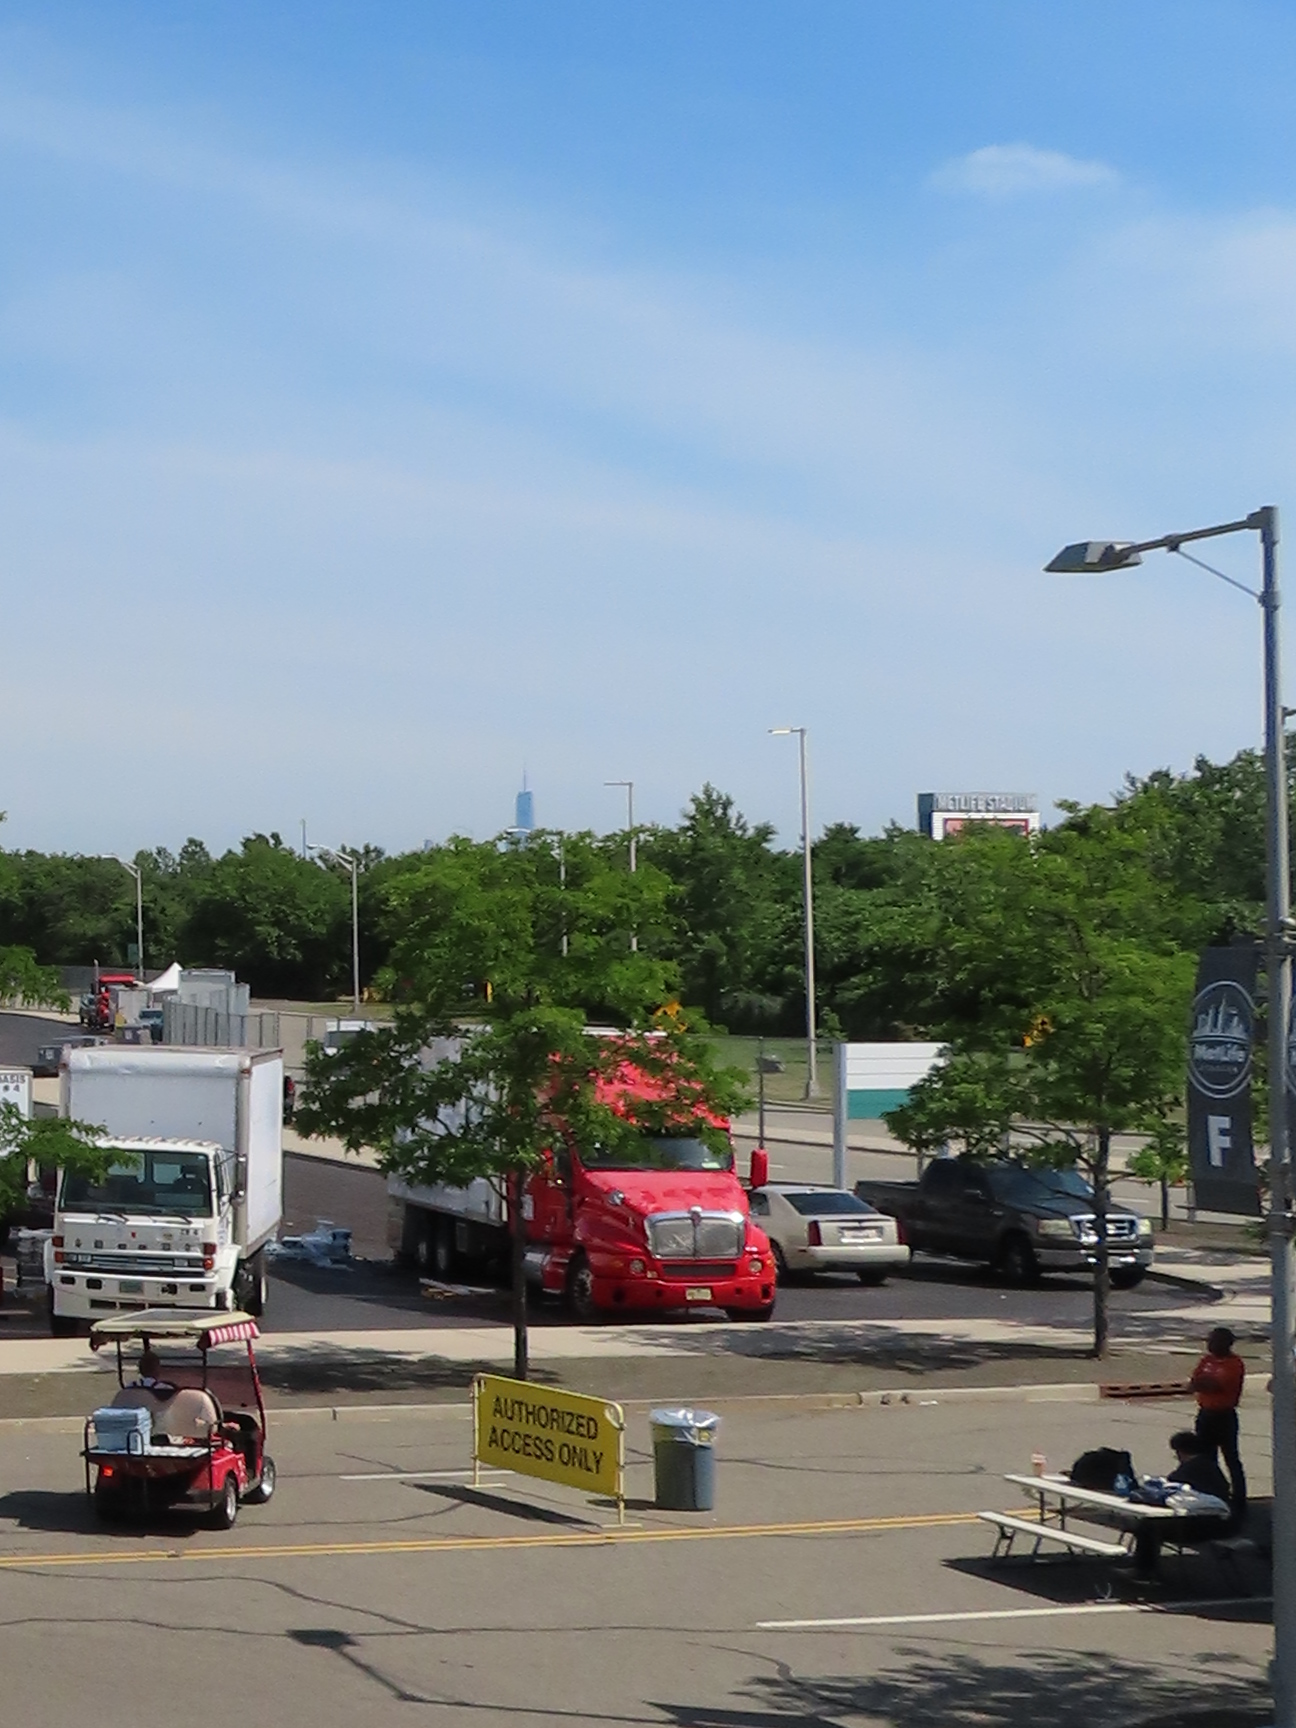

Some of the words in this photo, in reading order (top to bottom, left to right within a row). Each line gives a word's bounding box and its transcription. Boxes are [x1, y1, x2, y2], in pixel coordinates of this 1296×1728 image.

[1208, 1114, 1232, 1167] F
[494, 1396, 598, 1440] AUTHORIZED
[489, 1426, 554, 1462] ACCESS
[559, 1443, 603, 1474] ONLY
